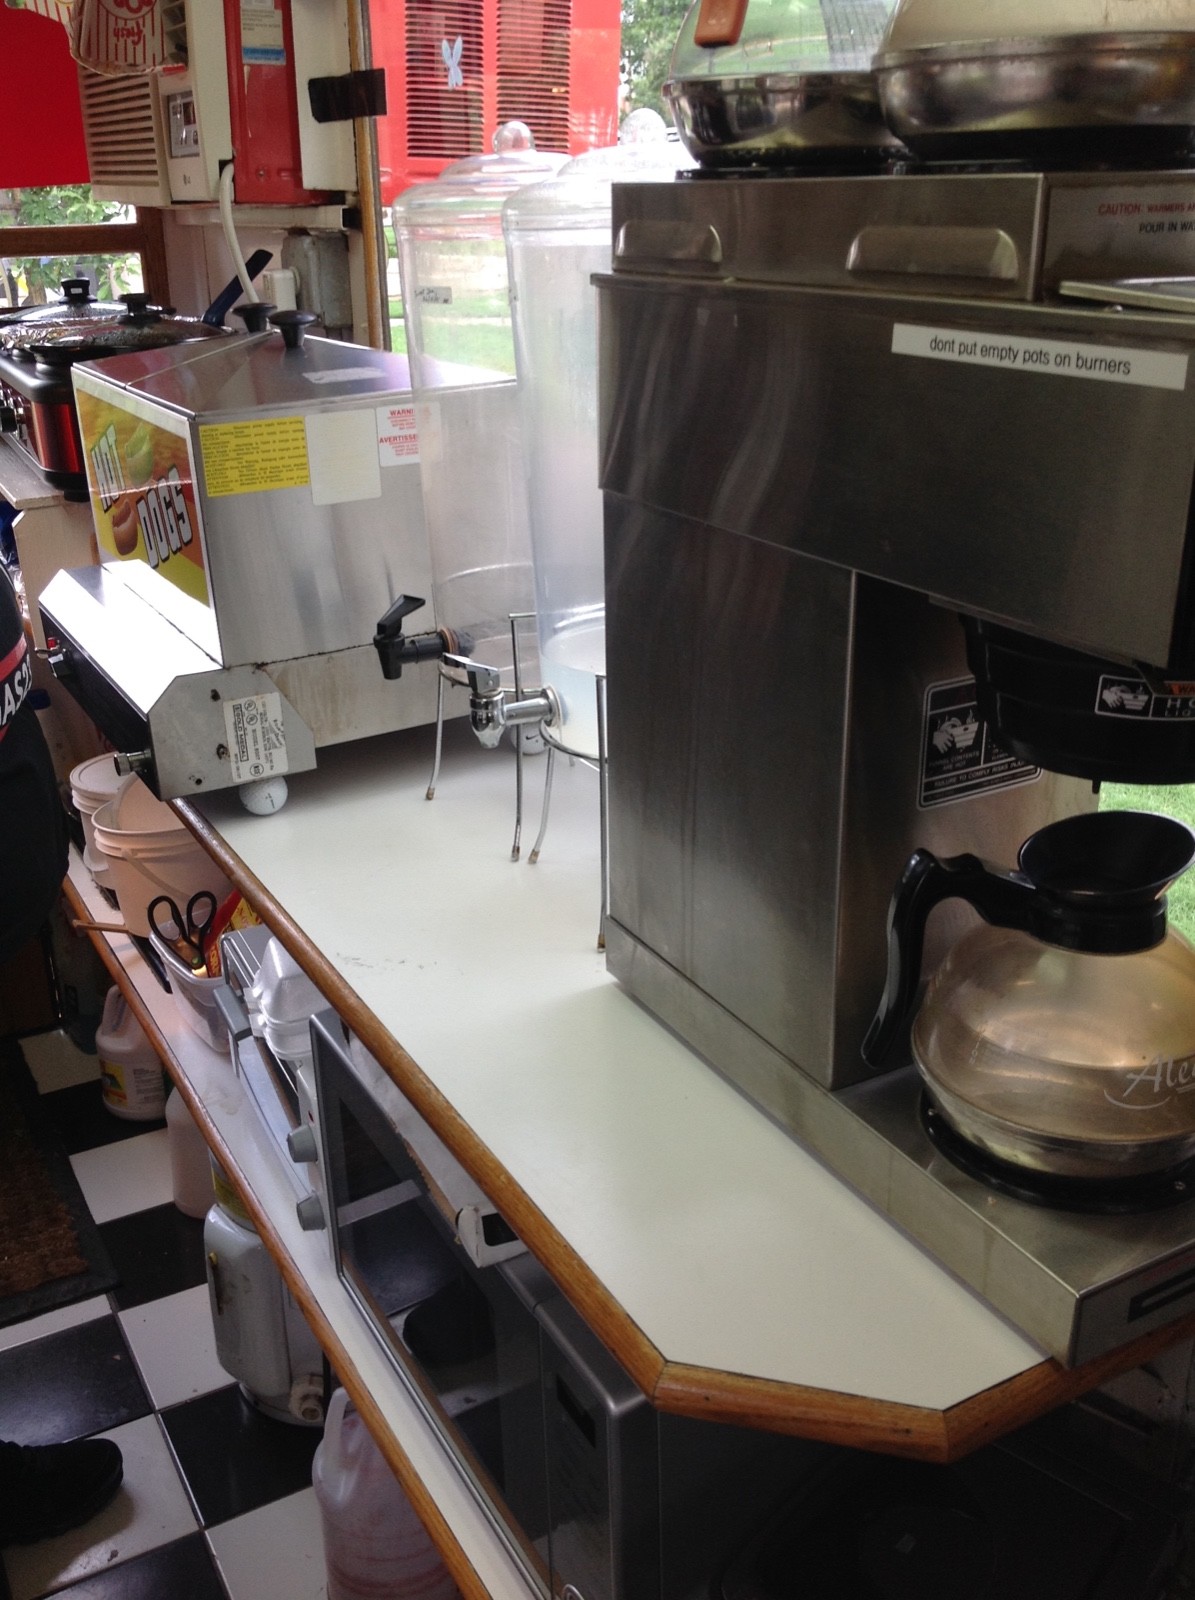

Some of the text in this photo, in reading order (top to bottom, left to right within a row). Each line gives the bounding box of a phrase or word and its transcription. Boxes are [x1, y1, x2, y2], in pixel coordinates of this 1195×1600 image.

[1139, 222, 1165, 234] POUR
[1167, 222, 1178, 232] IN
[929, 335, 1131, 376] dont put empty pots on burners
[91, 423, 126, 513] HOT
[136, 463, 193, 569] DOGS
[239, 734, 247, 759] MEDAL
